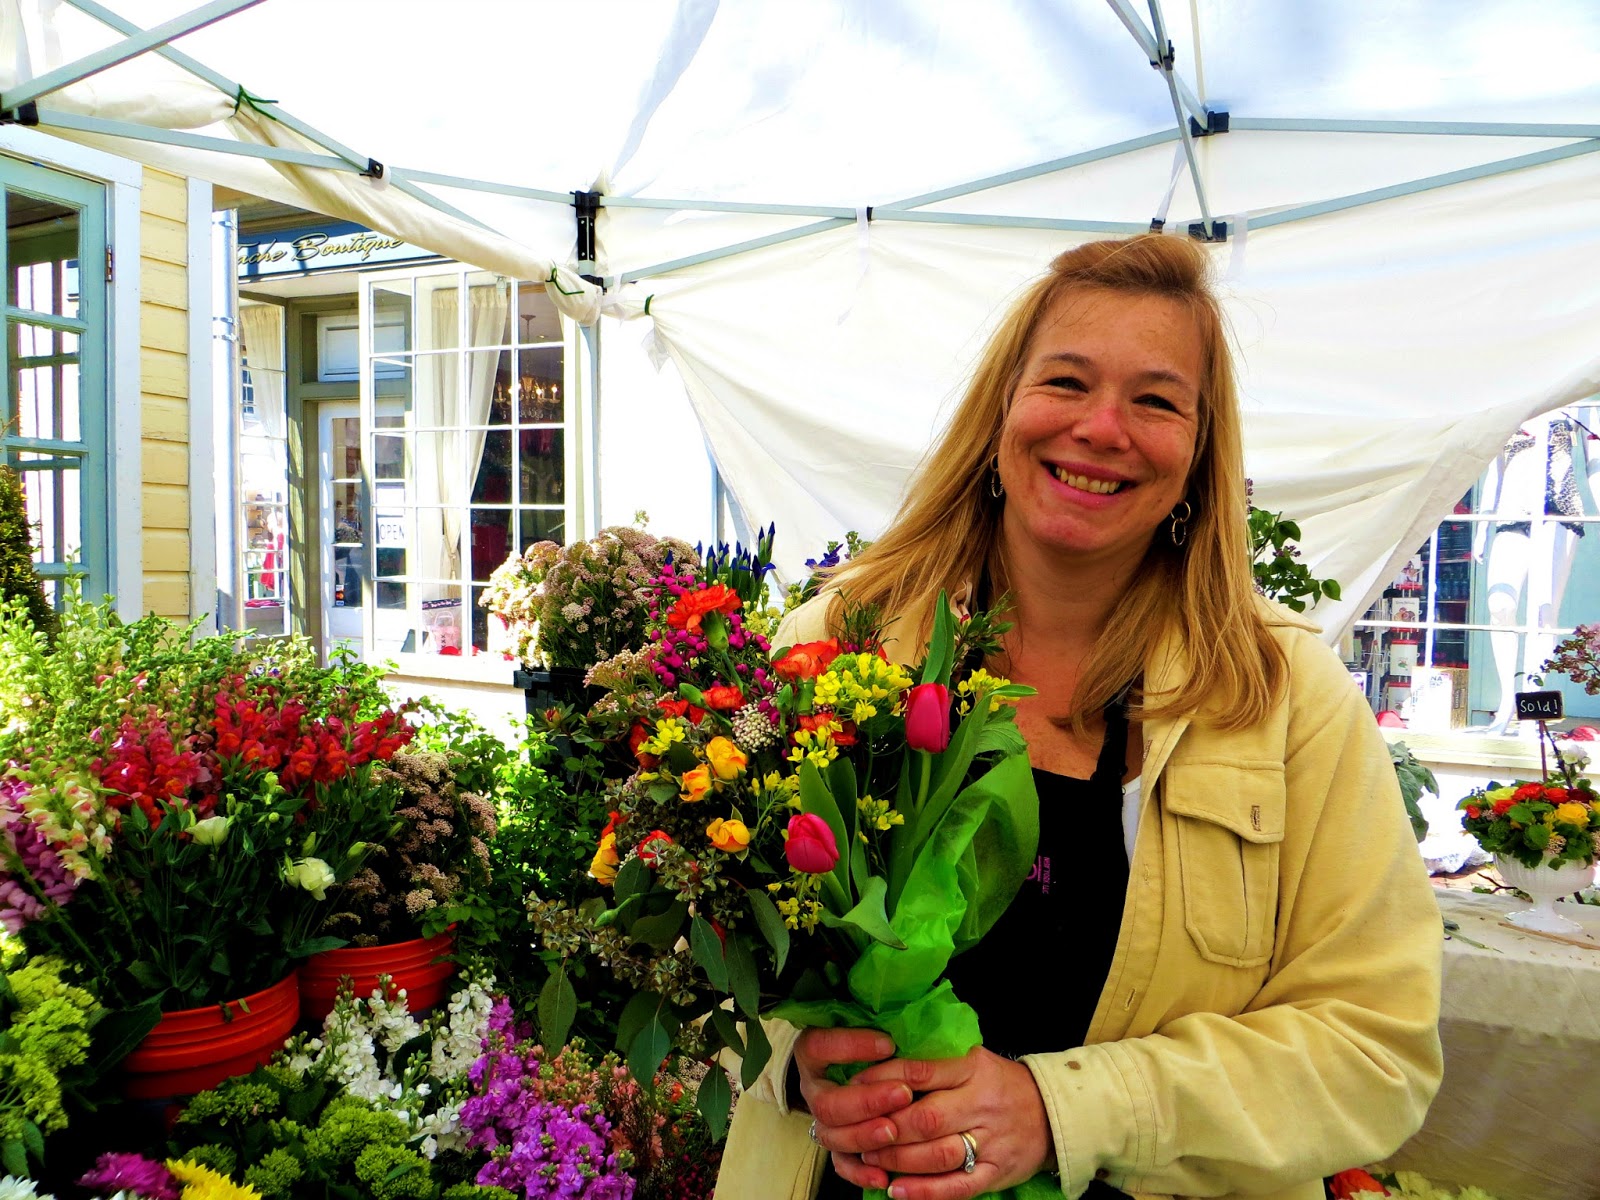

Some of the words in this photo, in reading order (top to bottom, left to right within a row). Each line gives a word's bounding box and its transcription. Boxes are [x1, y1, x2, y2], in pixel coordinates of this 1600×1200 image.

[291, 232, 404, 261] Boutique
[380, 523, 405, 540] OPEN
[1520, 699, 1558, 715] Sold!
